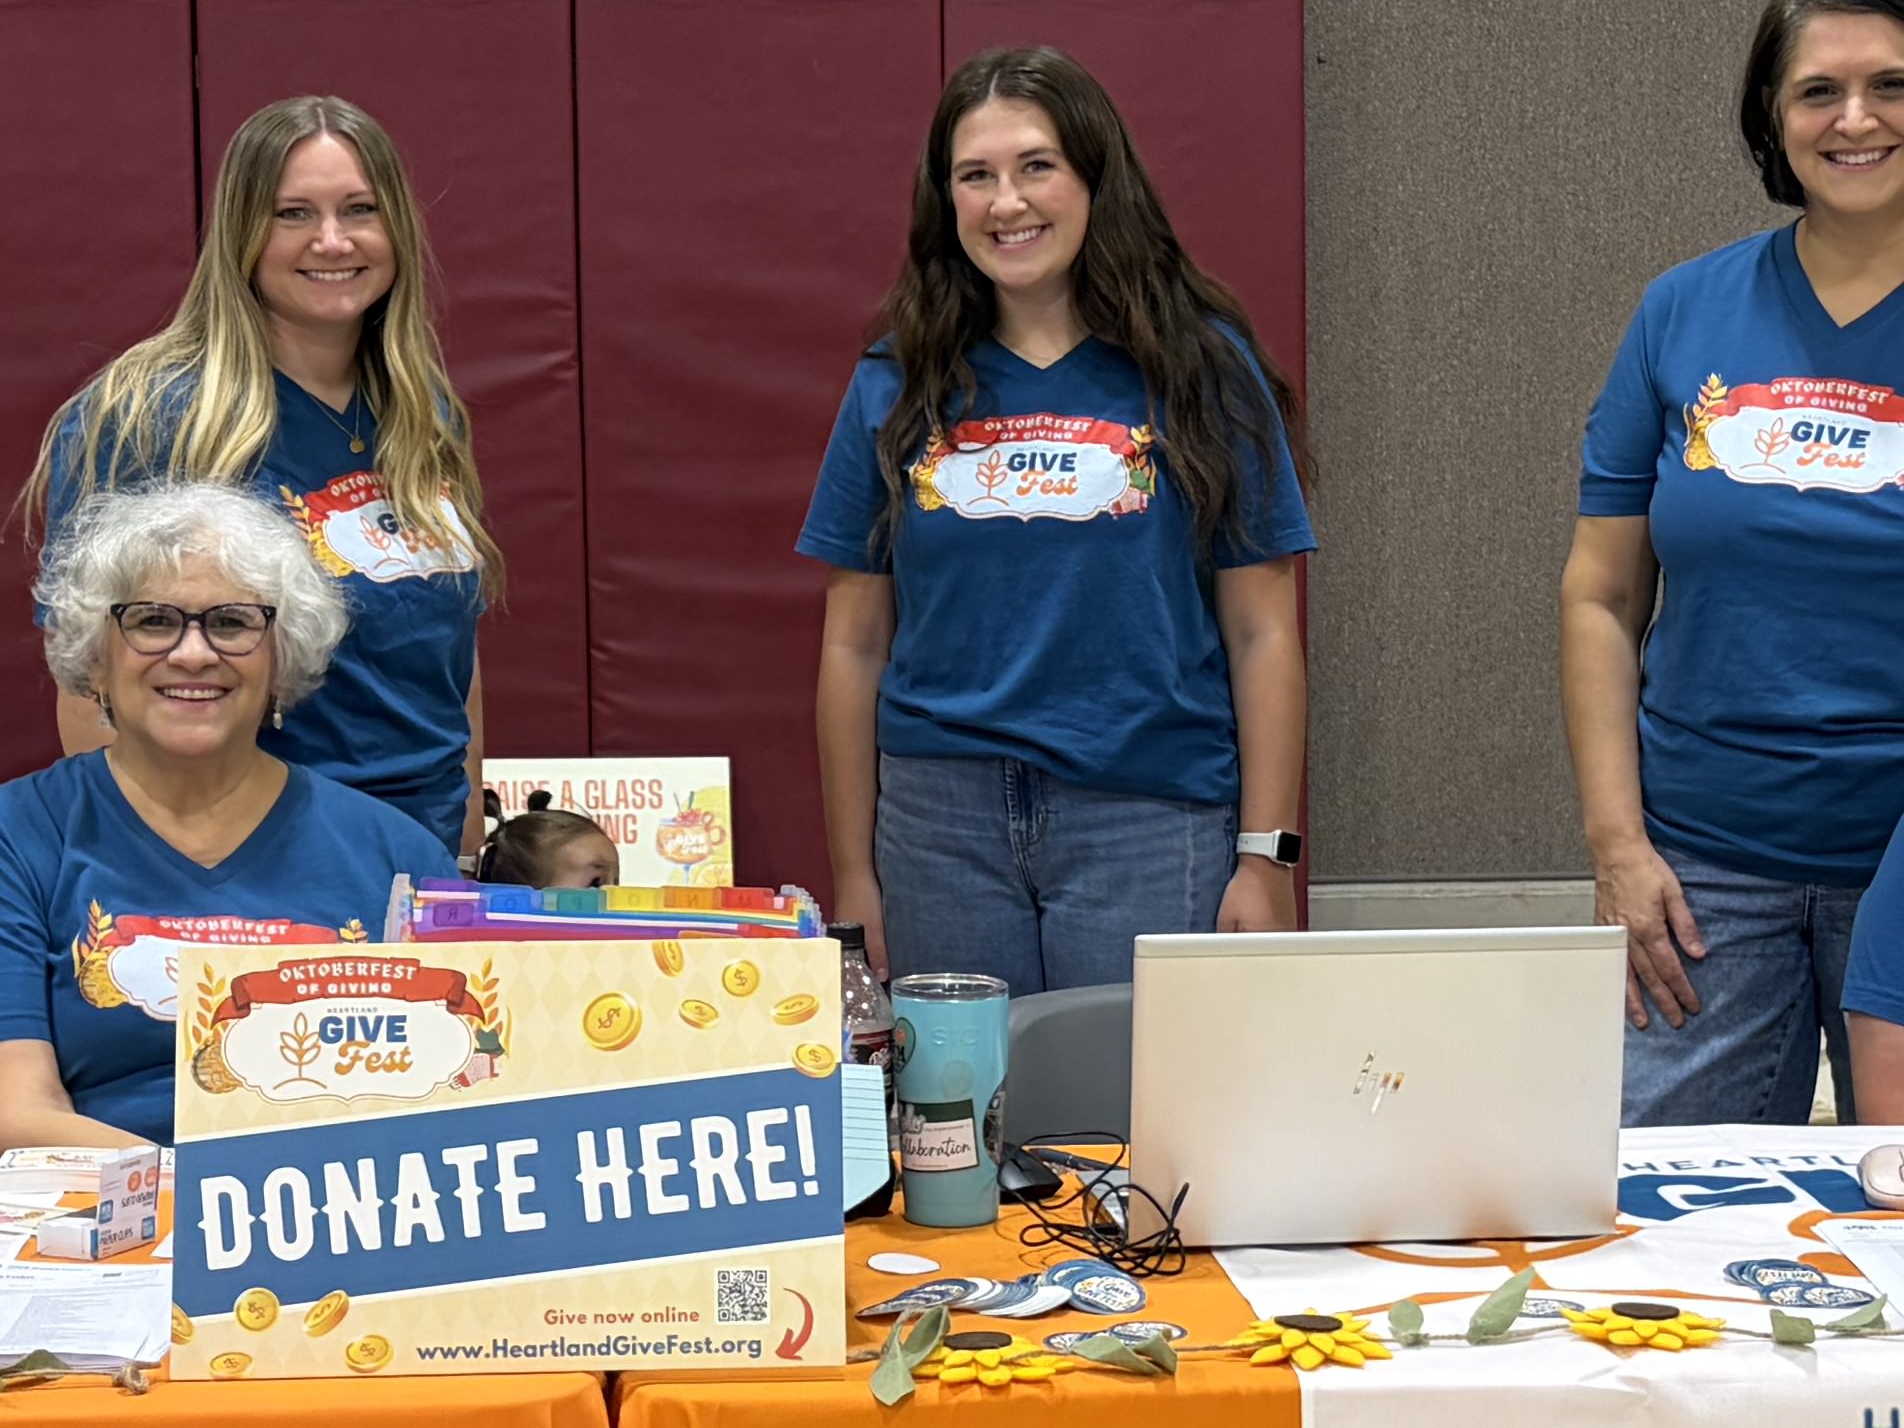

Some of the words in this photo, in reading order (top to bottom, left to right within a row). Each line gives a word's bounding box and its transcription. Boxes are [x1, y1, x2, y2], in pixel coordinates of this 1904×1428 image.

[1770, 378, 1890, 405] OKTOBERFEST
[1784, 394, 1805, 405] OF
[1810, 396, 1868, 414] GIVING
[983, 414, 1092, 432] OKTOBERFEST
[1790, 421, 1871, 449] GIVE
[1006, 451, 1078, 472] GIVE
[1796, 443, 1867, 470] Fest
[1015, 471, 1079, 496] Fest
[560, 779, 575, 811] A
[584, 779, 664, 811] GLASS
[159, 918, 290, 936] OKTOBERFEST
[279, 961, 418, 983] OKTOBERFEST
[296, 983, 320, 995] OF
[327, 982, 392, 994] GIVING
[318, 1014, 408, 1045] GIVE
[334, 1040, 414, 1076] Fest
[197, 1137, 547, 1272] DONATE
[575, 1104, 822, 1224] HERE!
[543, 1309, 588, 1326] Give
[593, 1311, 635, 1325] now
[641, 1307, 700, 1324] online
[415, 1334, 763, 1360] www.HeartlandGiveFest.org
